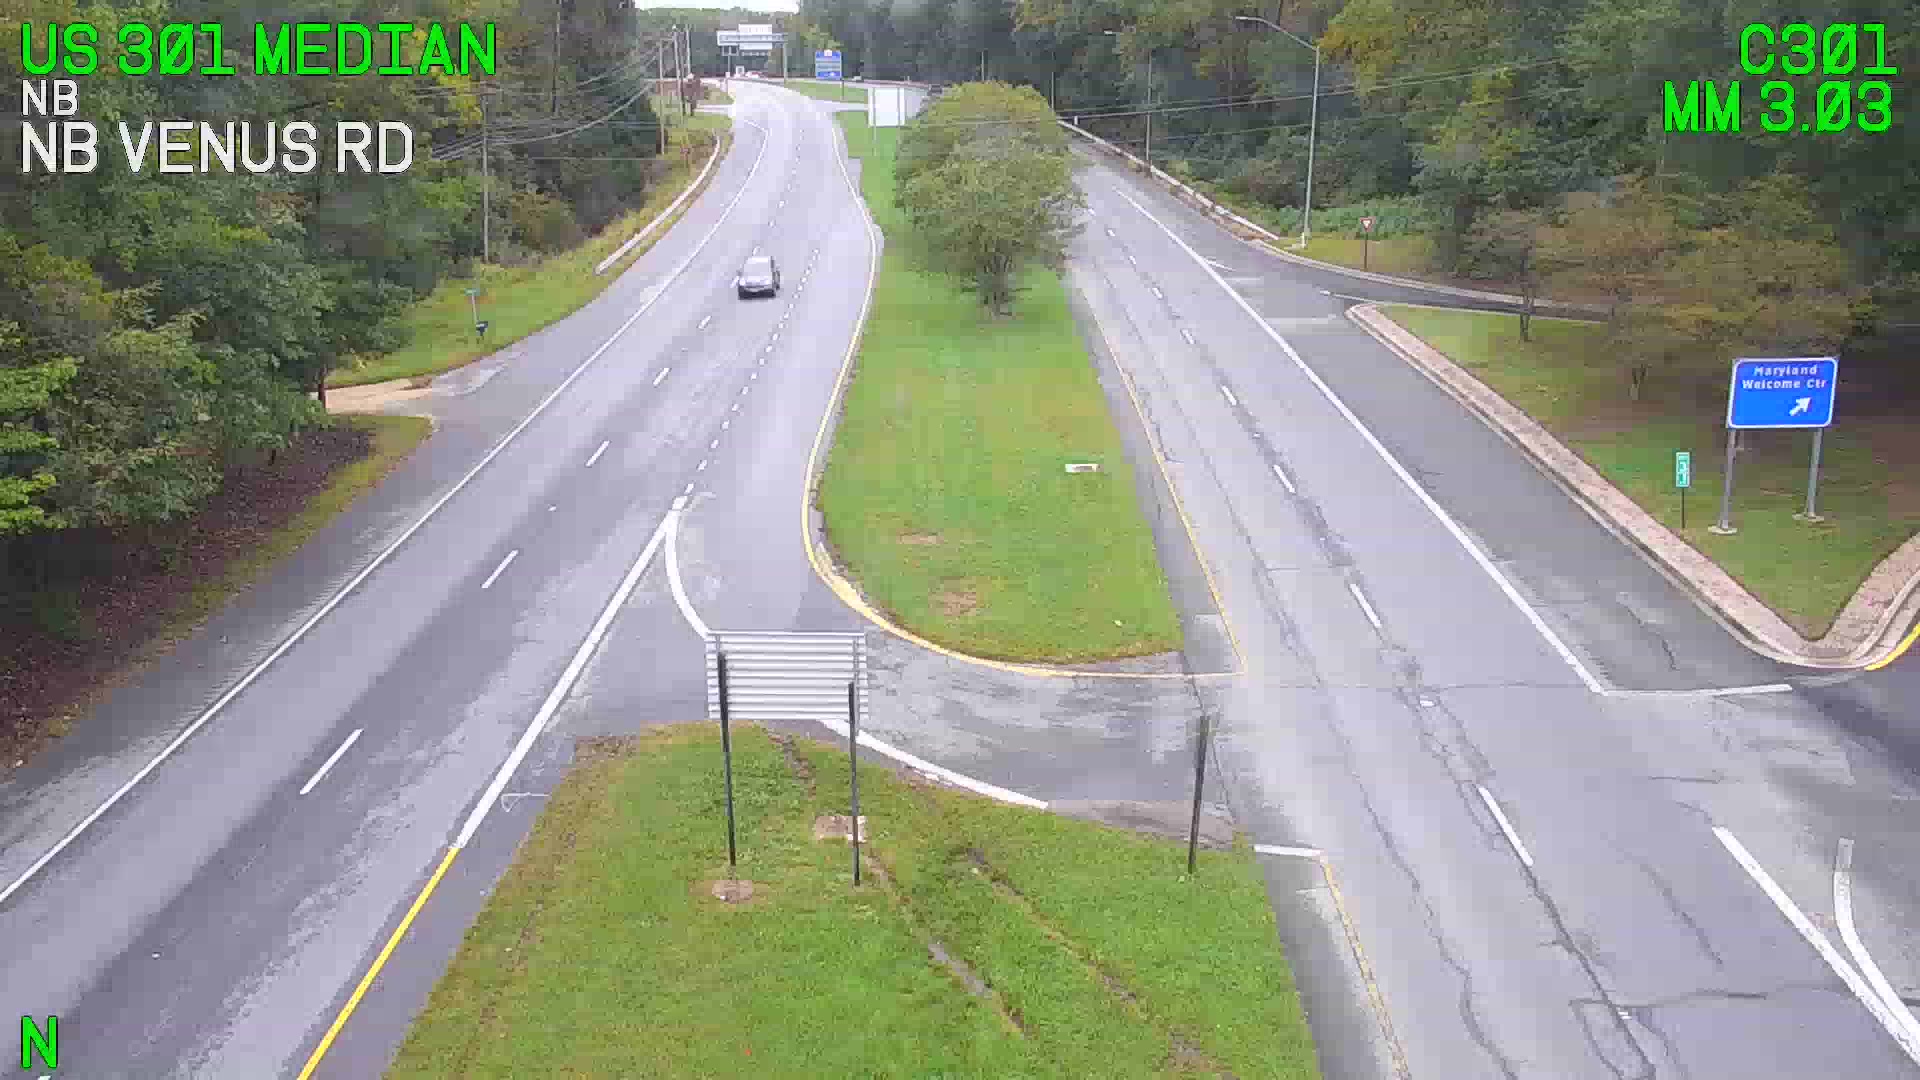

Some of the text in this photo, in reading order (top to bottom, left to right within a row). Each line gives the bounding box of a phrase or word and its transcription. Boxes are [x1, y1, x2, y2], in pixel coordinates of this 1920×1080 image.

[1753, 364, 1817, 377] Maryland
[1741, 378, 1827, 389] Welcome Ctr
